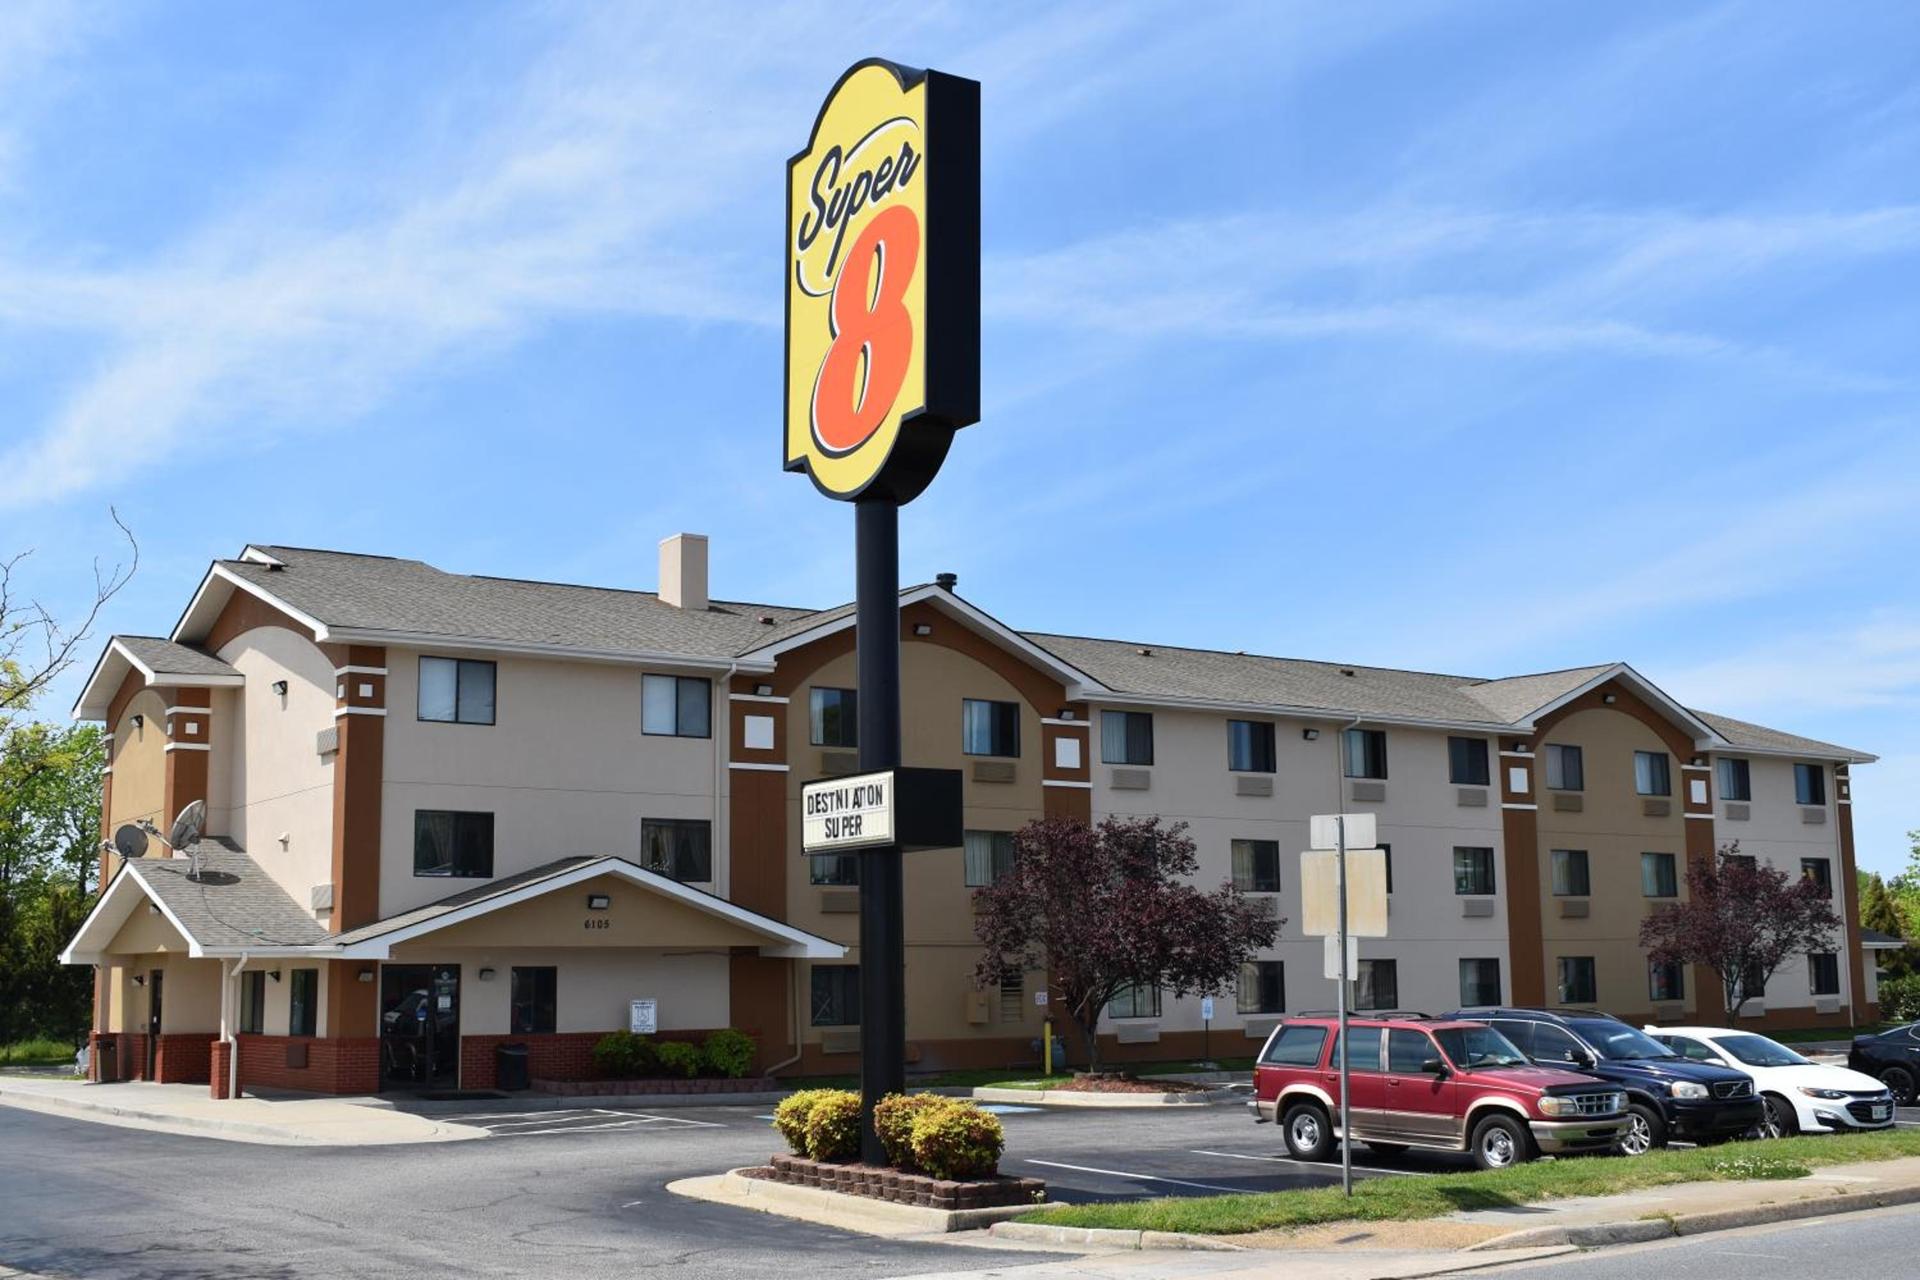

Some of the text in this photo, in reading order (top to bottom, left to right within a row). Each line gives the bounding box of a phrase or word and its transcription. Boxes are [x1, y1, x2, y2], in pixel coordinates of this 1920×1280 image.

[799, 141, 921, 277] Super
[810, 204, 921, 458] 8
[584, 919, 610, 929] 6105
